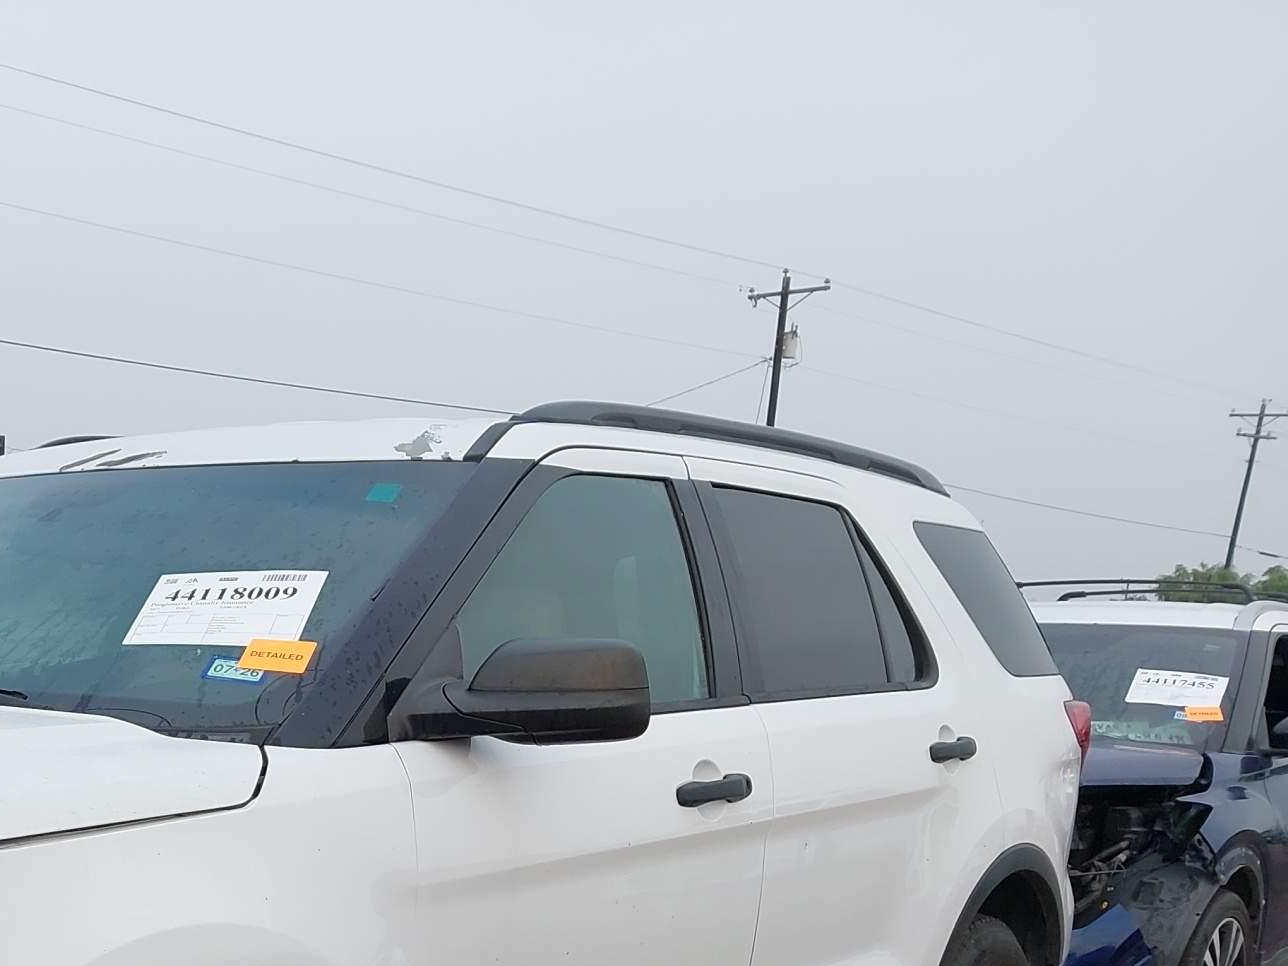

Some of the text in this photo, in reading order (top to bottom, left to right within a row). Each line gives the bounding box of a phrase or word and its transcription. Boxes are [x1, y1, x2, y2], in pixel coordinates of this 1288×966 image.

[165, 586, 298, 602] 44118009
[250, 651, 304, 661] DETAILED
[1143, 677, 1216, 689] 44117455
